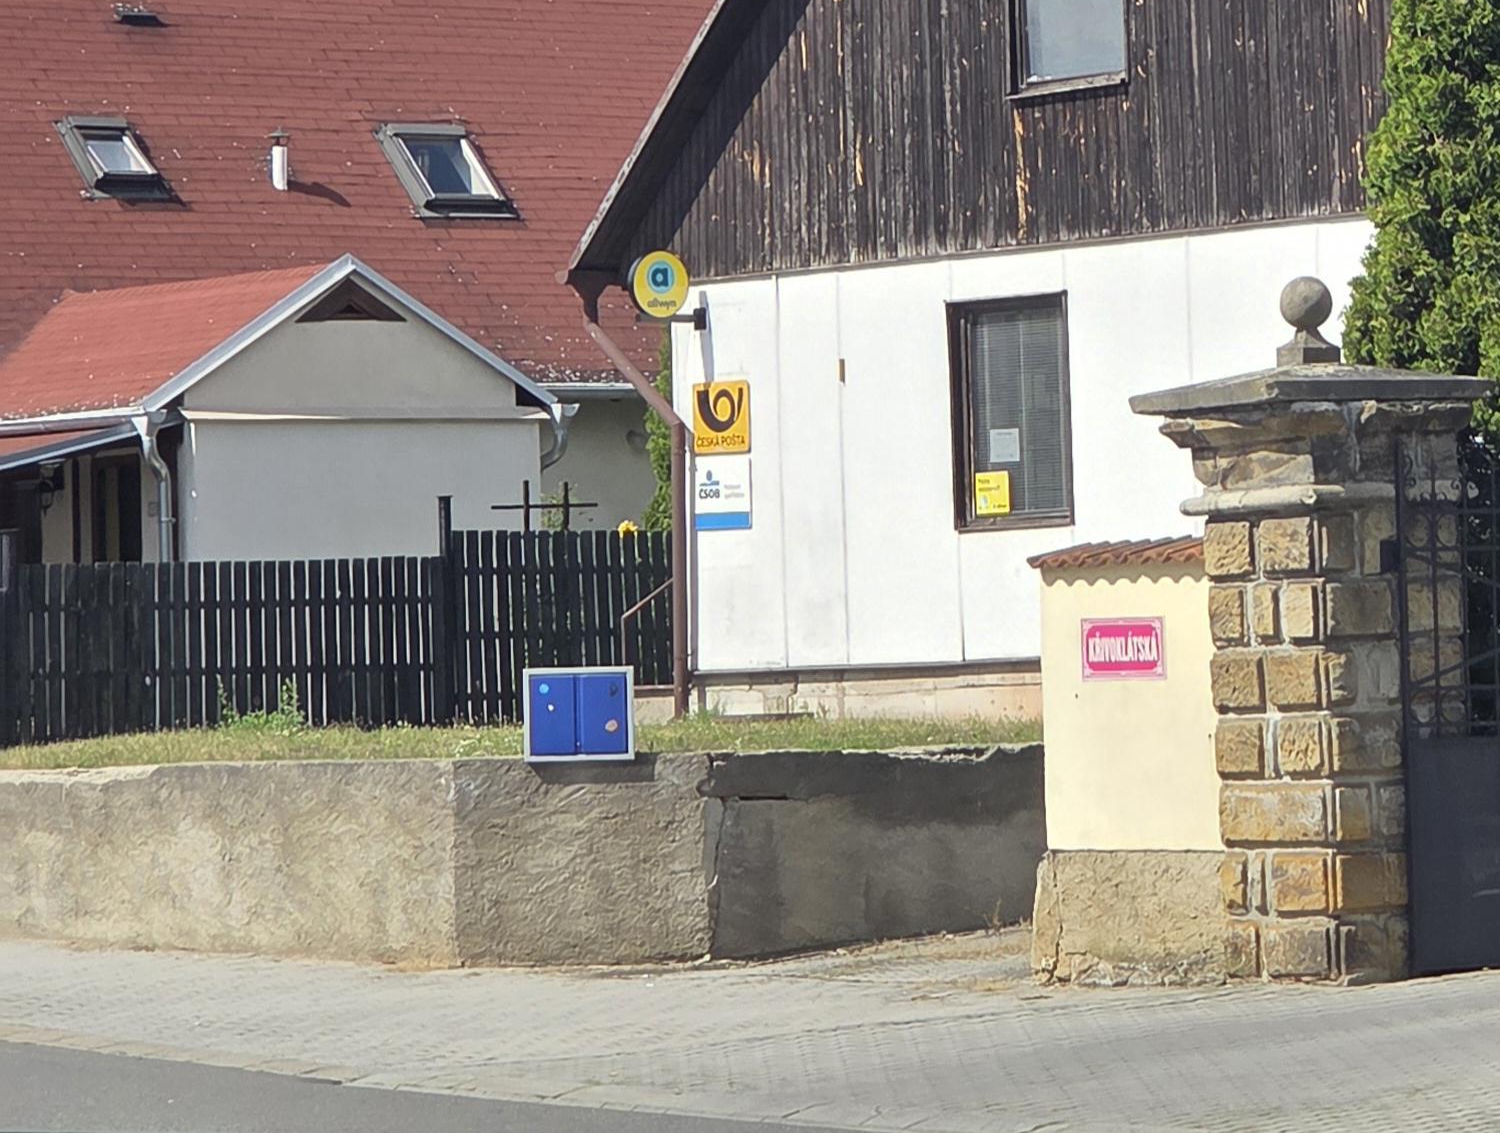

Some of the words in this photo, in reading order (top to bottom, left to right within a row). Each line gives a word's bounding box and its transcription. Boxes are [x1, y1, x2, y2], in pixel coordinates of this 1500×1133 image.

[696, 435, 719, 448] ČESKÁ
[721, 433, 745, 446] POŠTA
[698, 487, 720, 499] ČSOB
[1088, 630, 1158, 663] KŘIVOKLÁTSKÁ
